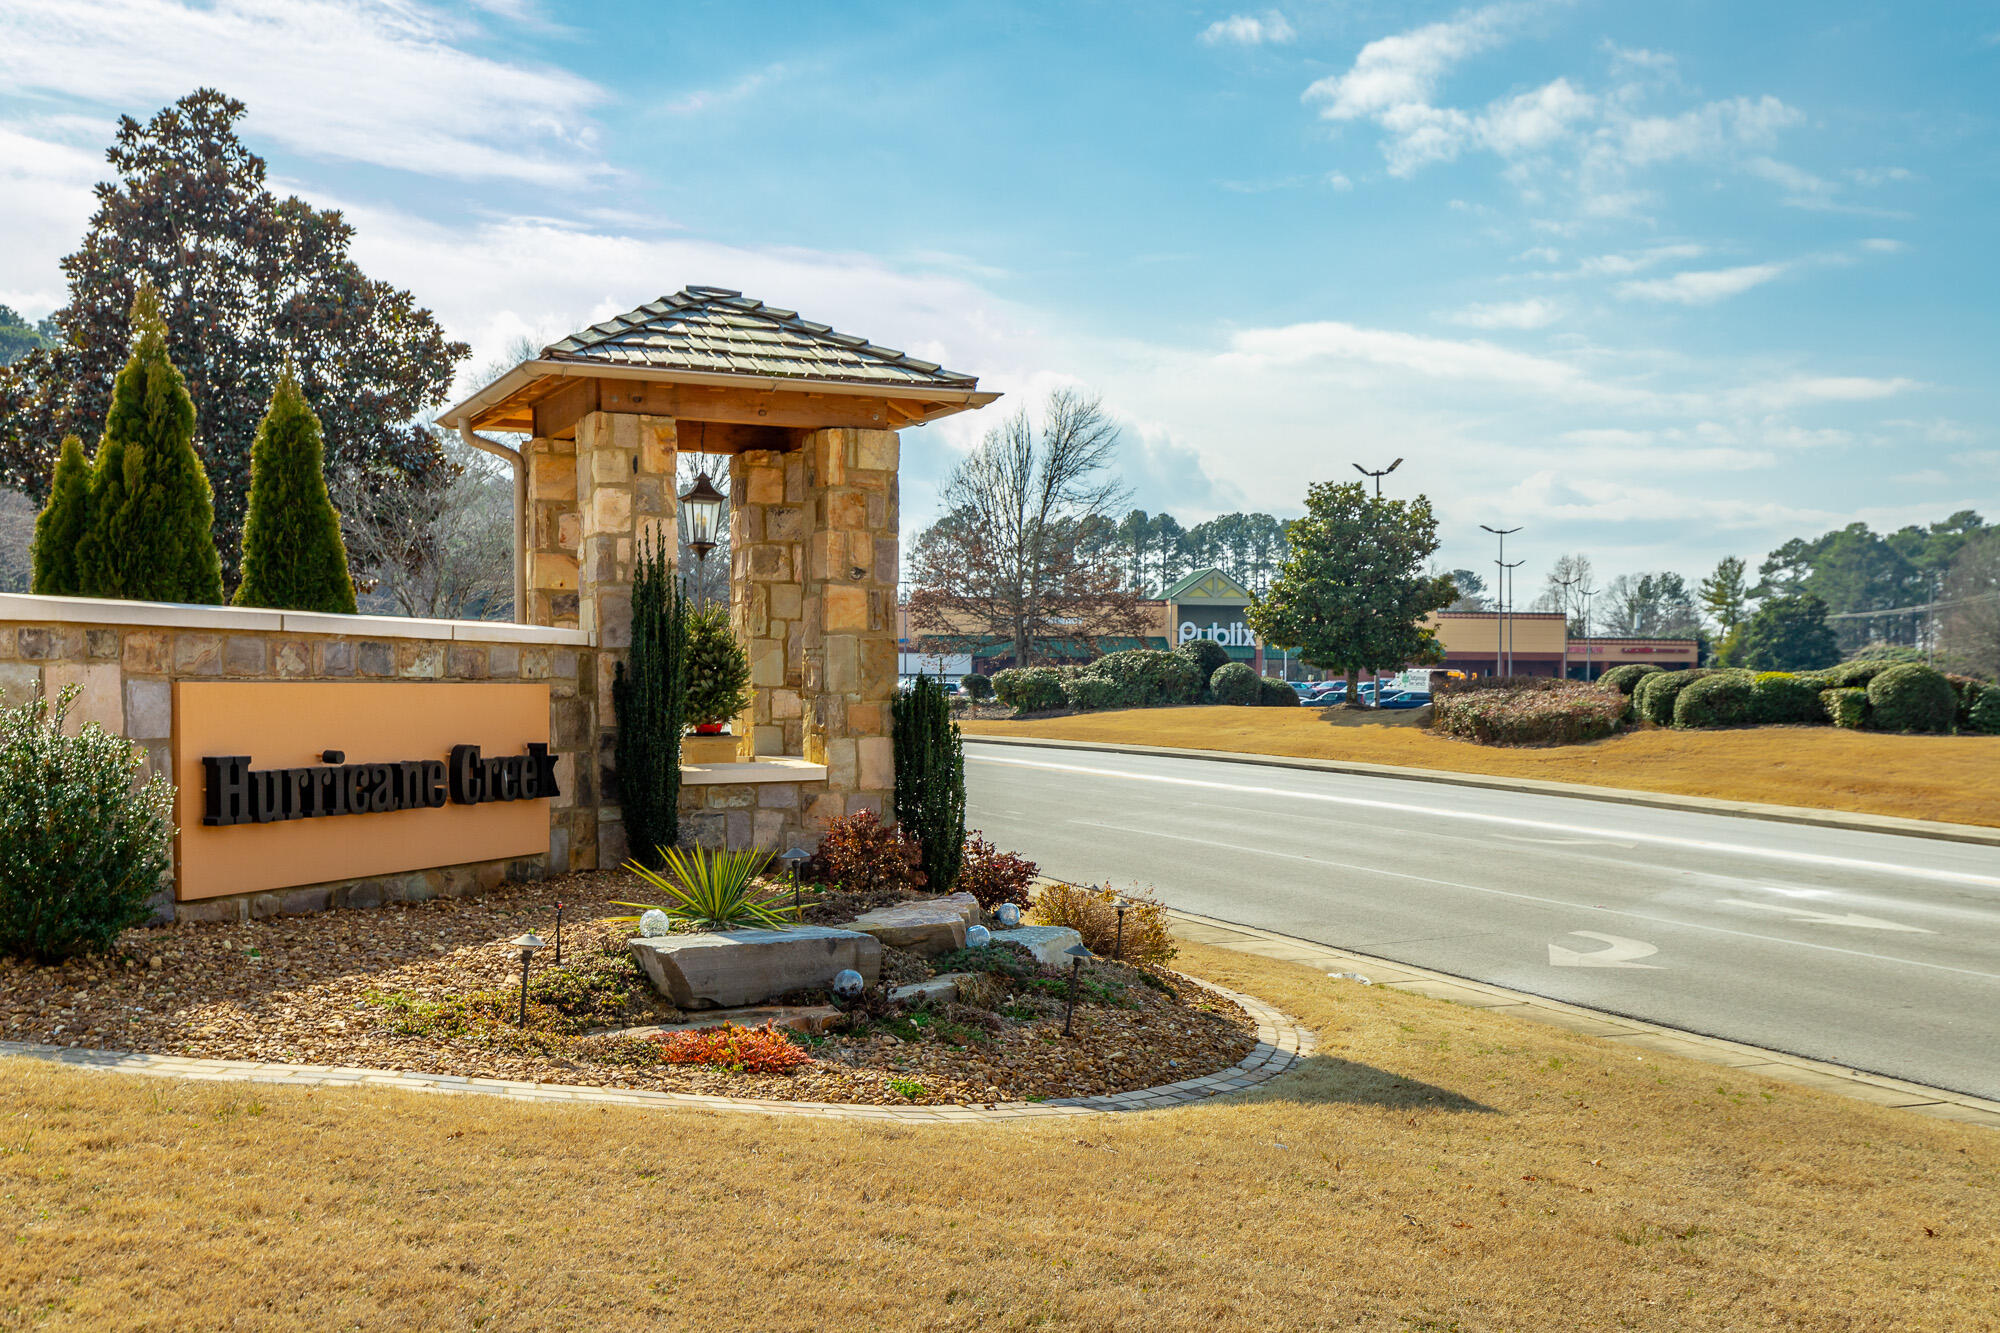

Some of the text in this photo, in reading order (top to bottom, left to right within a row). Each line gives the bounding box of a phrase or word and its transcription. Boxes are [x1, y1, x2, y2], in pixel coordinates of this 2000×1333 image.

[1179, 621, 1257, 646] Publix
[202, 743, 560, 826] Hurricane Creek
